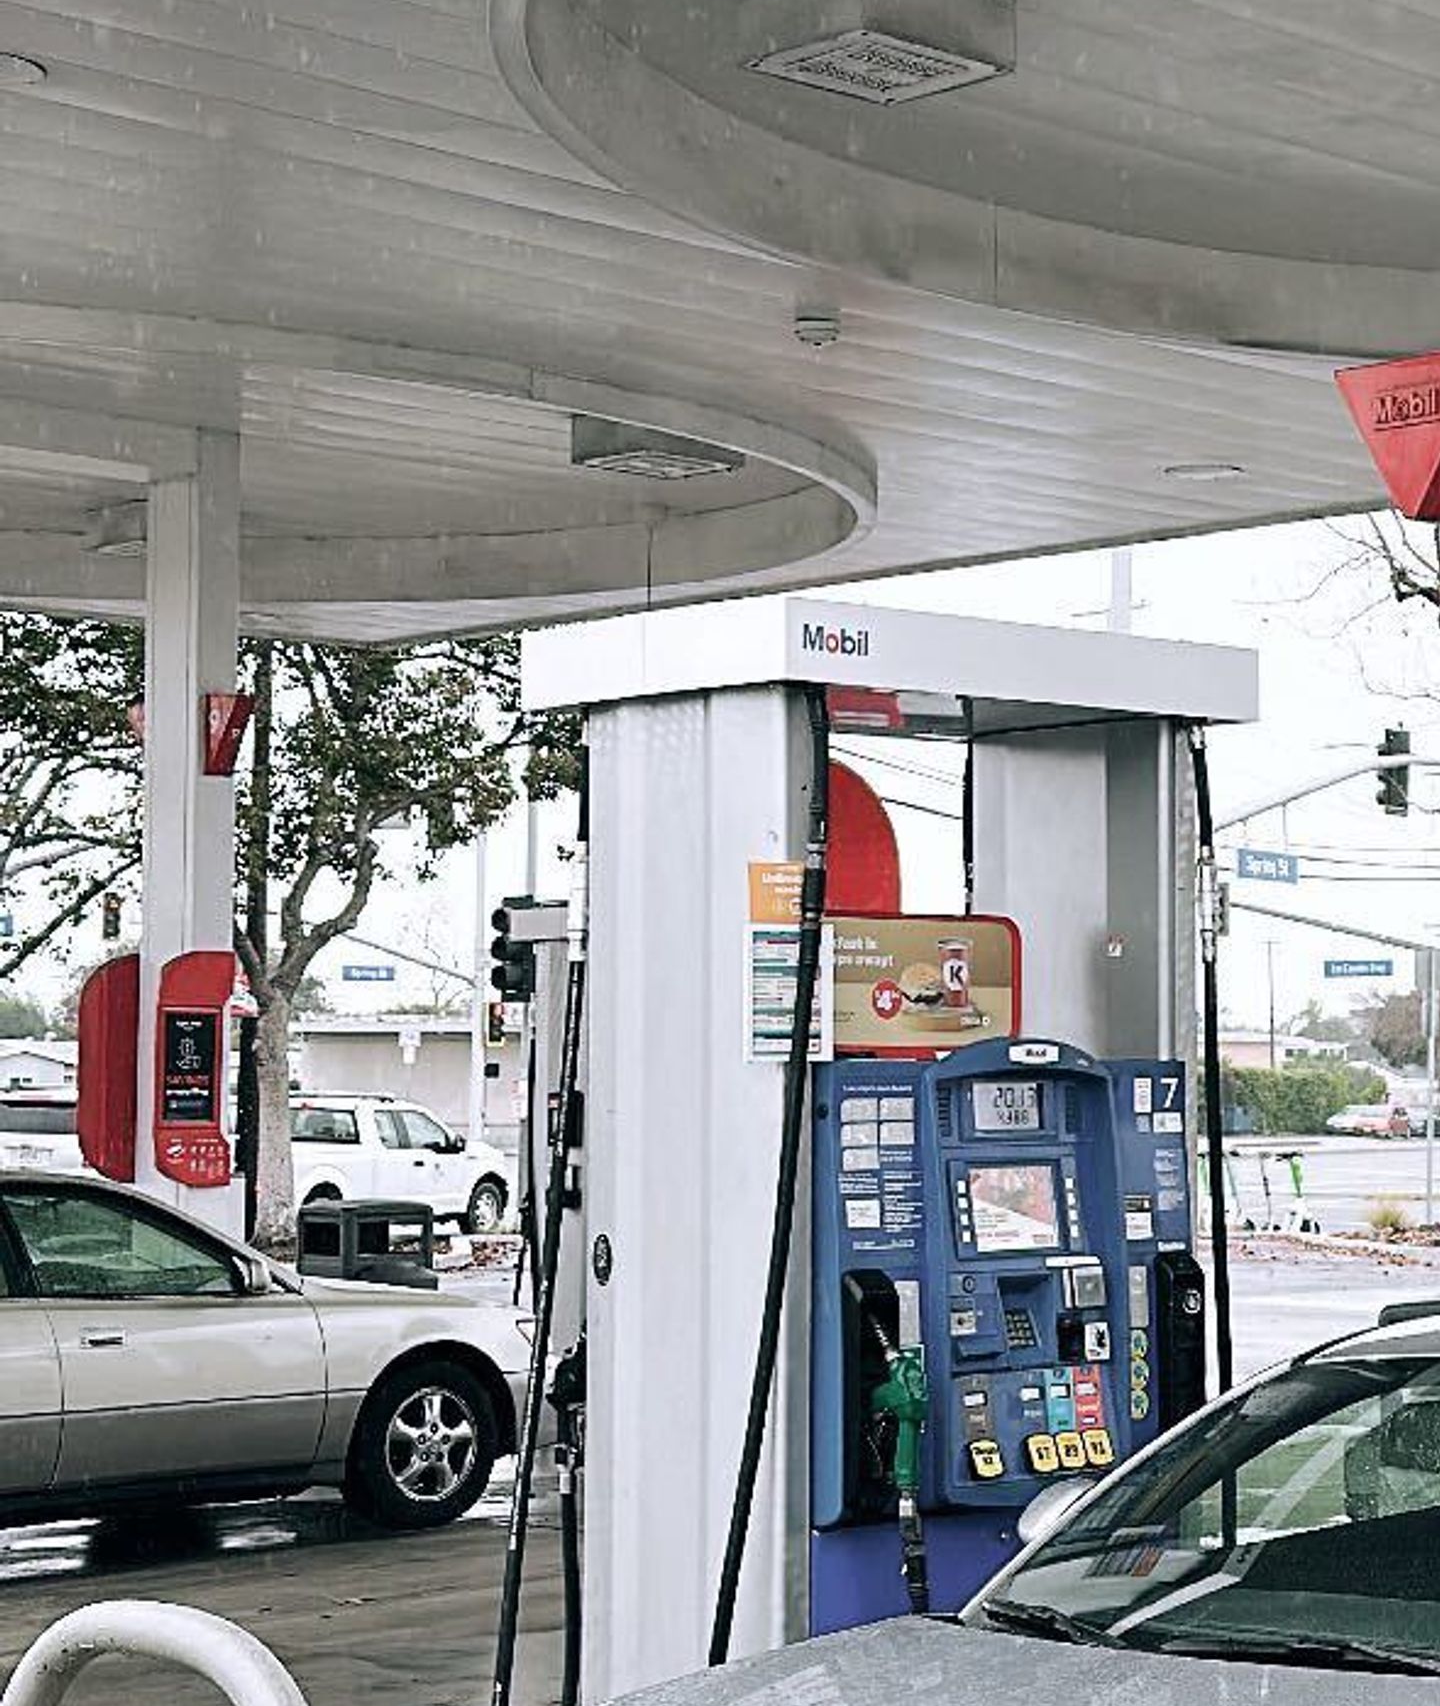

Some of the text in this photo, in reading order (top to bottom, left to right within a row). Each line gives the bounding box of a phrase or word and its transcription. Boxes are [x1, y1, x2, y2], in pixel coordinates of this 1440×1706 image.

[1375, 389, 1437, 424] Mobil
[803, 623, 868, 656] Mobil
[949, 965, 962, 985] K
[1160, 1077, 1179, 1108] 7
